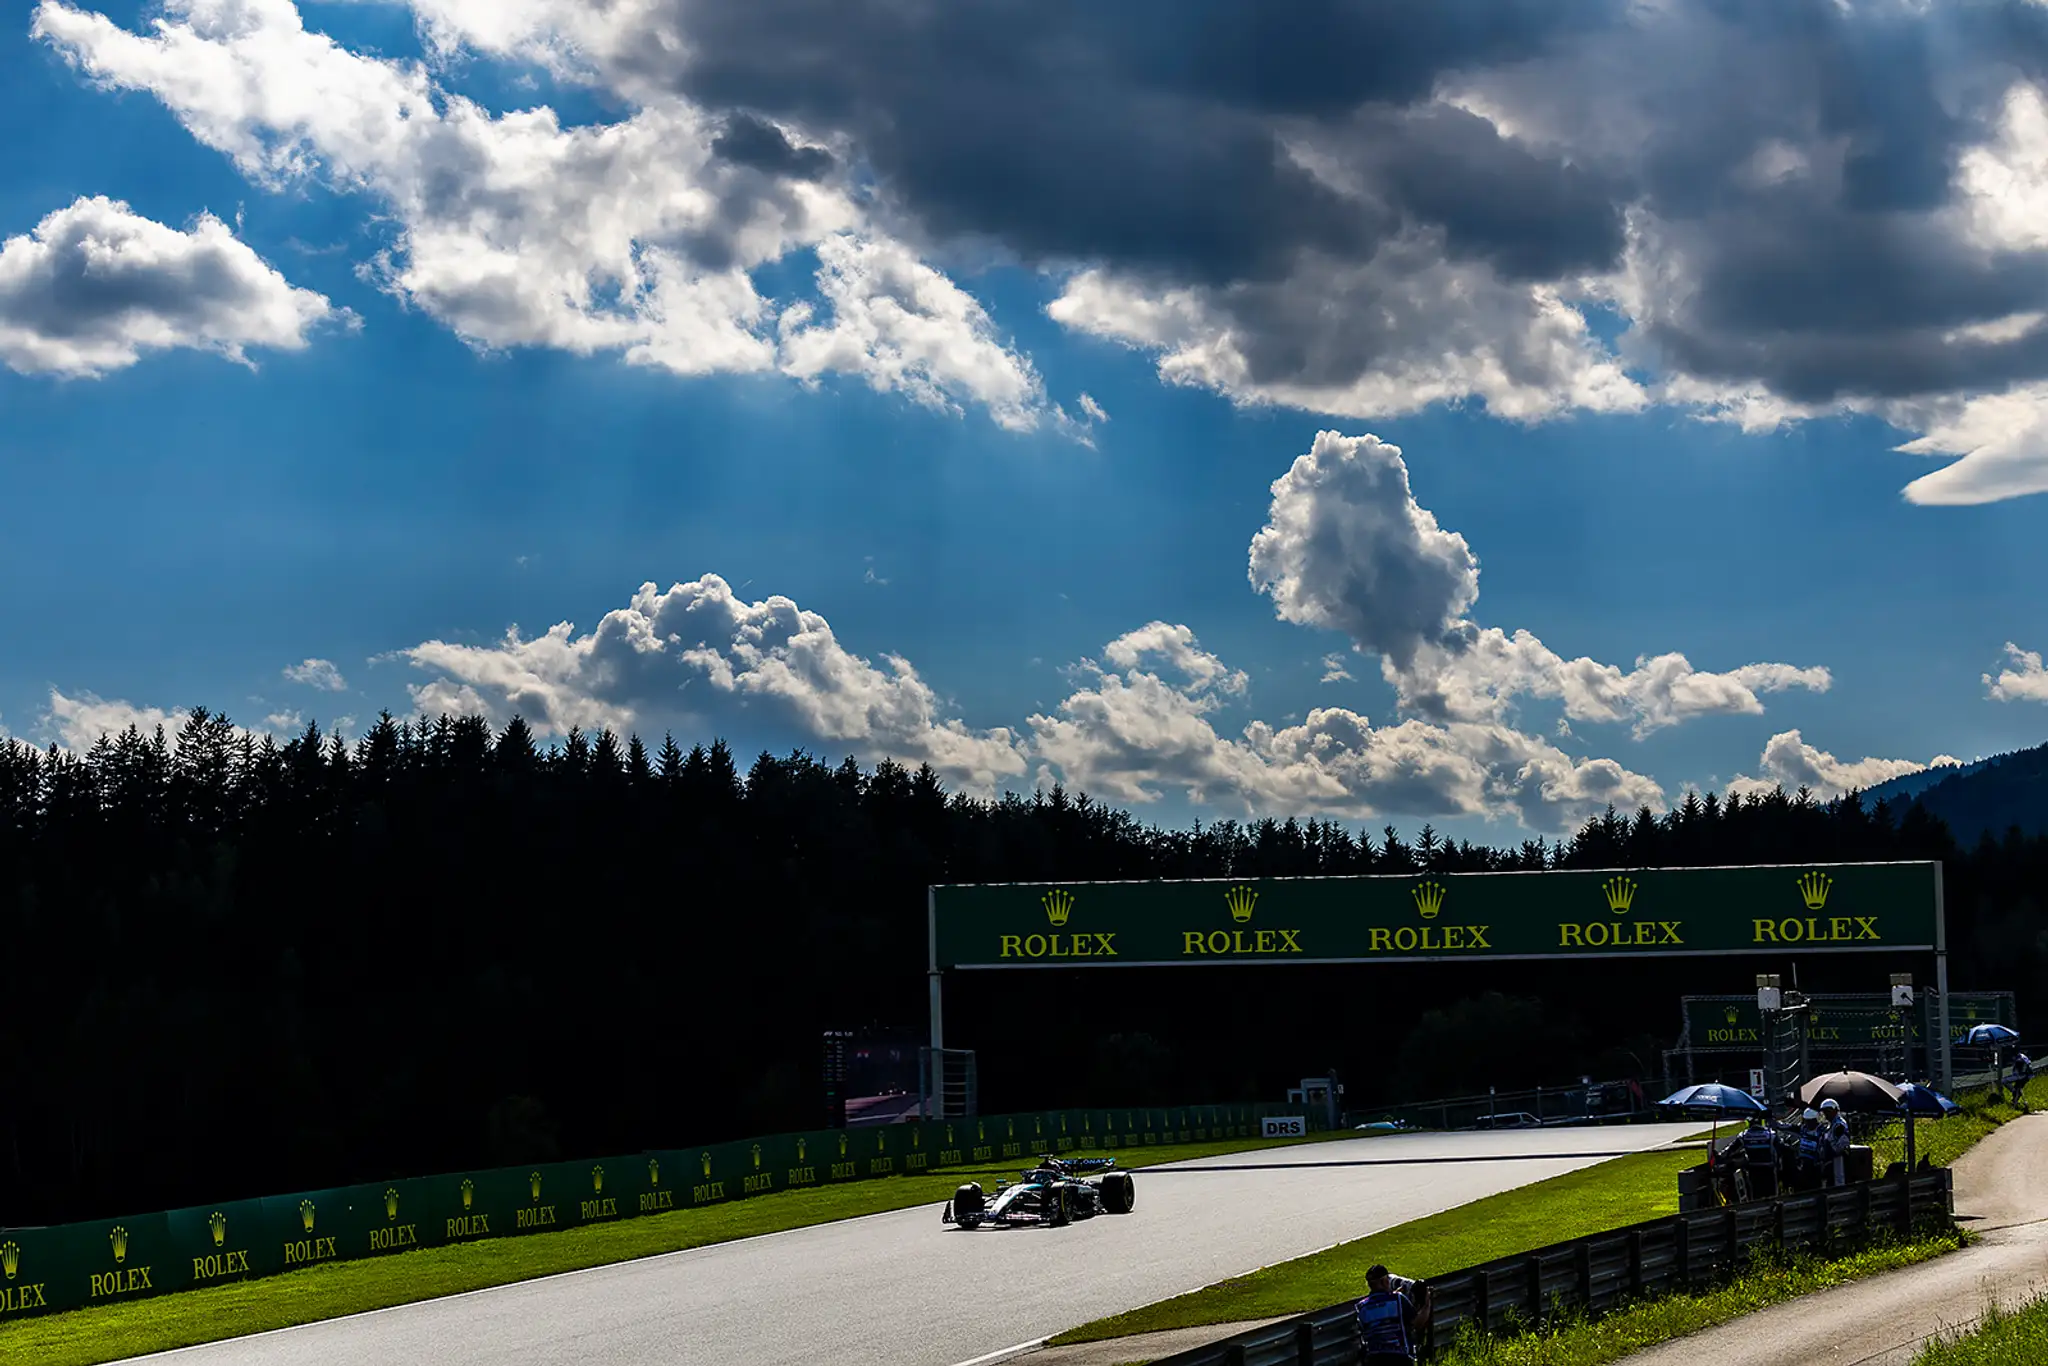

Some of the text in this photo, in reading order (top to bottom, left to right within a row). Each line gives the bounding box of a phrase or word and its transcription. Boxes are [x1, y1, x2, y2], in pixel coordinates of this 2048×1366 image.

[1000, 916, 1881, 957] ROLEX ROLEX ROLEX ROLEX ROLEX
[1707, 1028, 1758, 1041] ROLEX
[1871, 1025, 1919, 1038] ROLX
[1266, 1121, 1300, 1135] DRS
[0, 1283, 47, 1312] LEX
[90, 1266, 153, 1297] ROLEX
[192, 1250, 250, 1280] ROLEX
[284, 1236, 337, 1264] ROLEX
[369, 1224, 417, 1250] ROLEX
[446, 1214, 490, 1238] ROLEX
[516, 1205, 556, 1228] ROLEX
[581, 1198, 617, 1220] ROLEX
[639, 1190, 673, 1212] ROLEX
[693, 1182, 724, 1204] ROLEX
[744, 1172, 772, 1193] ROLEX
[788, 1166, 816, 1184] ROLEX
[831, 1161, 856, 1179] ROLEX
[870, 1156, 894, 1174] ROLEX
[906, 1152, 928, 1169] ROLEX
